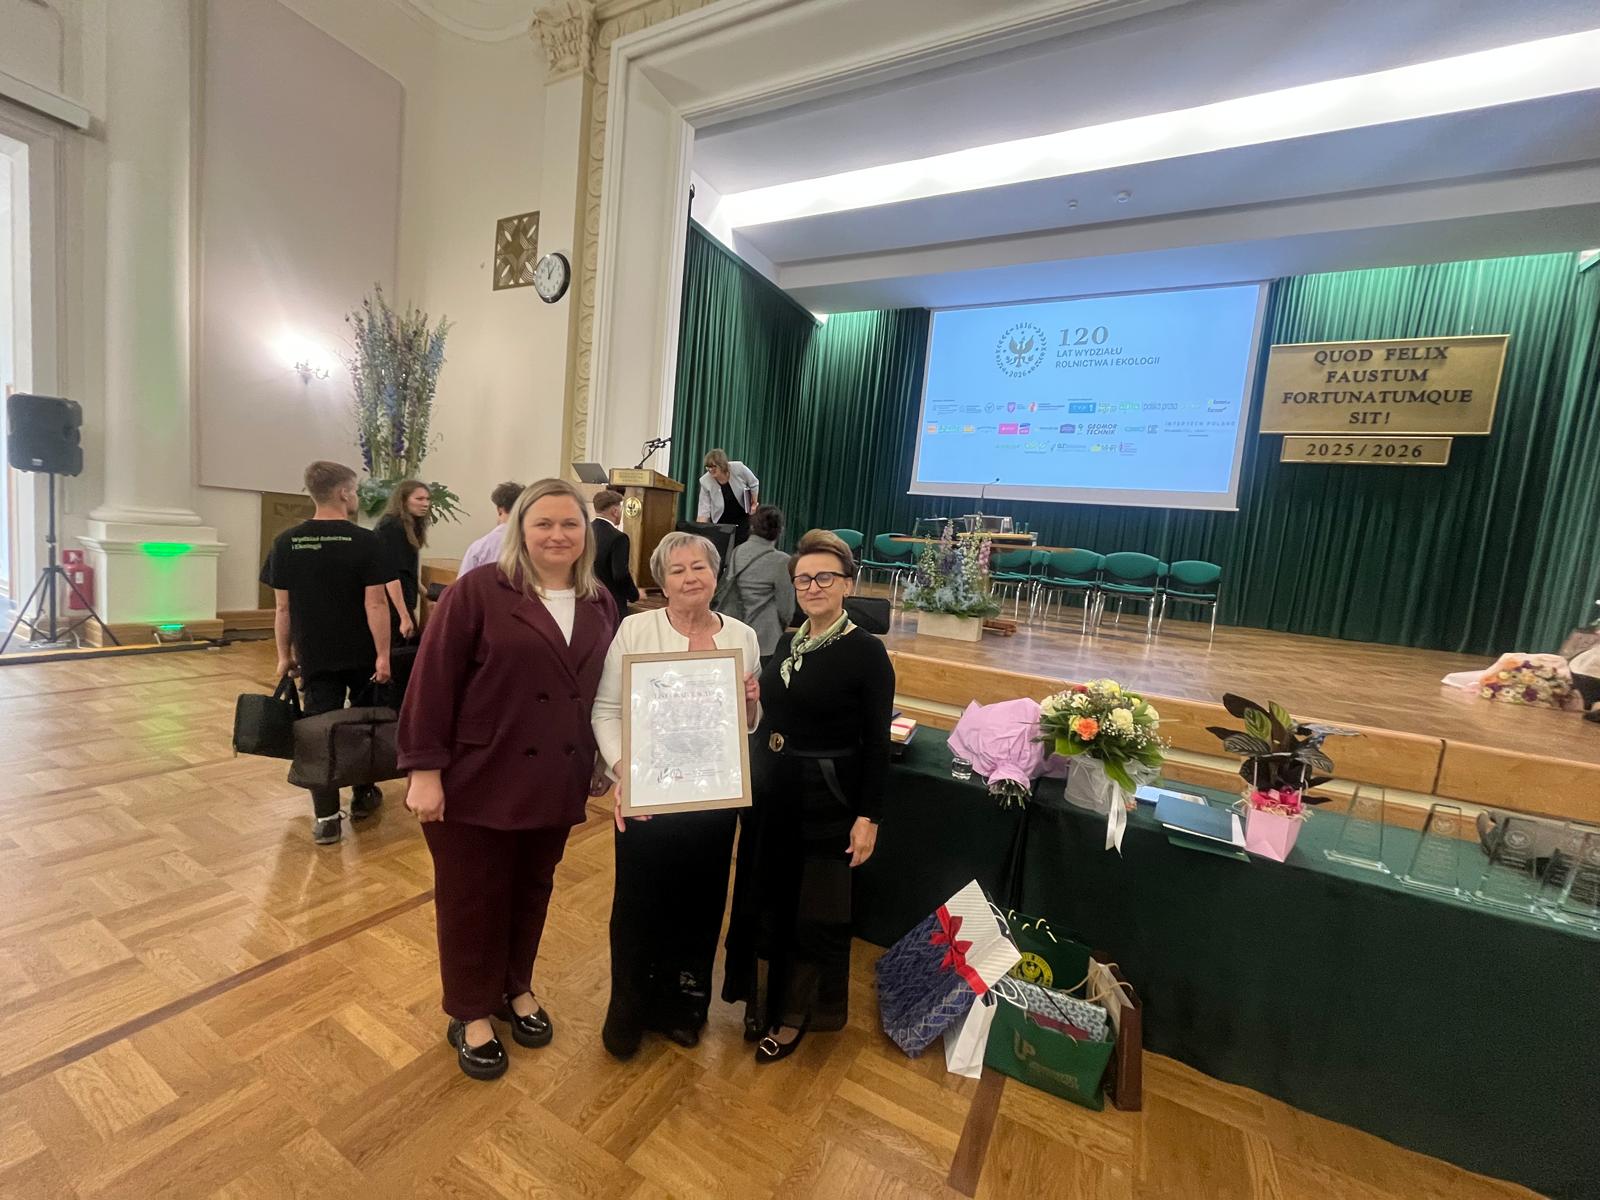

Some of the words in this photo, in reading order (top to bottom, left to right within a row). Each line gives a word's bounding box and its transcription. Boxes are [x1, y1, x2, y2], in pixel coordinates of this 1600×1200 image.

[1058, 325, 1109, 347] 120
[1056, 349, 1073, 358] LAT
[1074, 347, 1123, 357] WYDZIAŁU
[1314, 349, 1373, 365] QUOD
[1384, 346, 1450, 362] FELIX
[1055, 359, 1109, 368] ROLNICTWA
[1115, 357, 1161, 366] EKOLOGII
[1325, 368, 1430, 383] FAUSTUM
[1281, 389, 1473, 406] FORTUNATUMQUE
[1349, 411, 1391, 425] SIT!
[1305, 443, 1424, 458] 2025/2026
